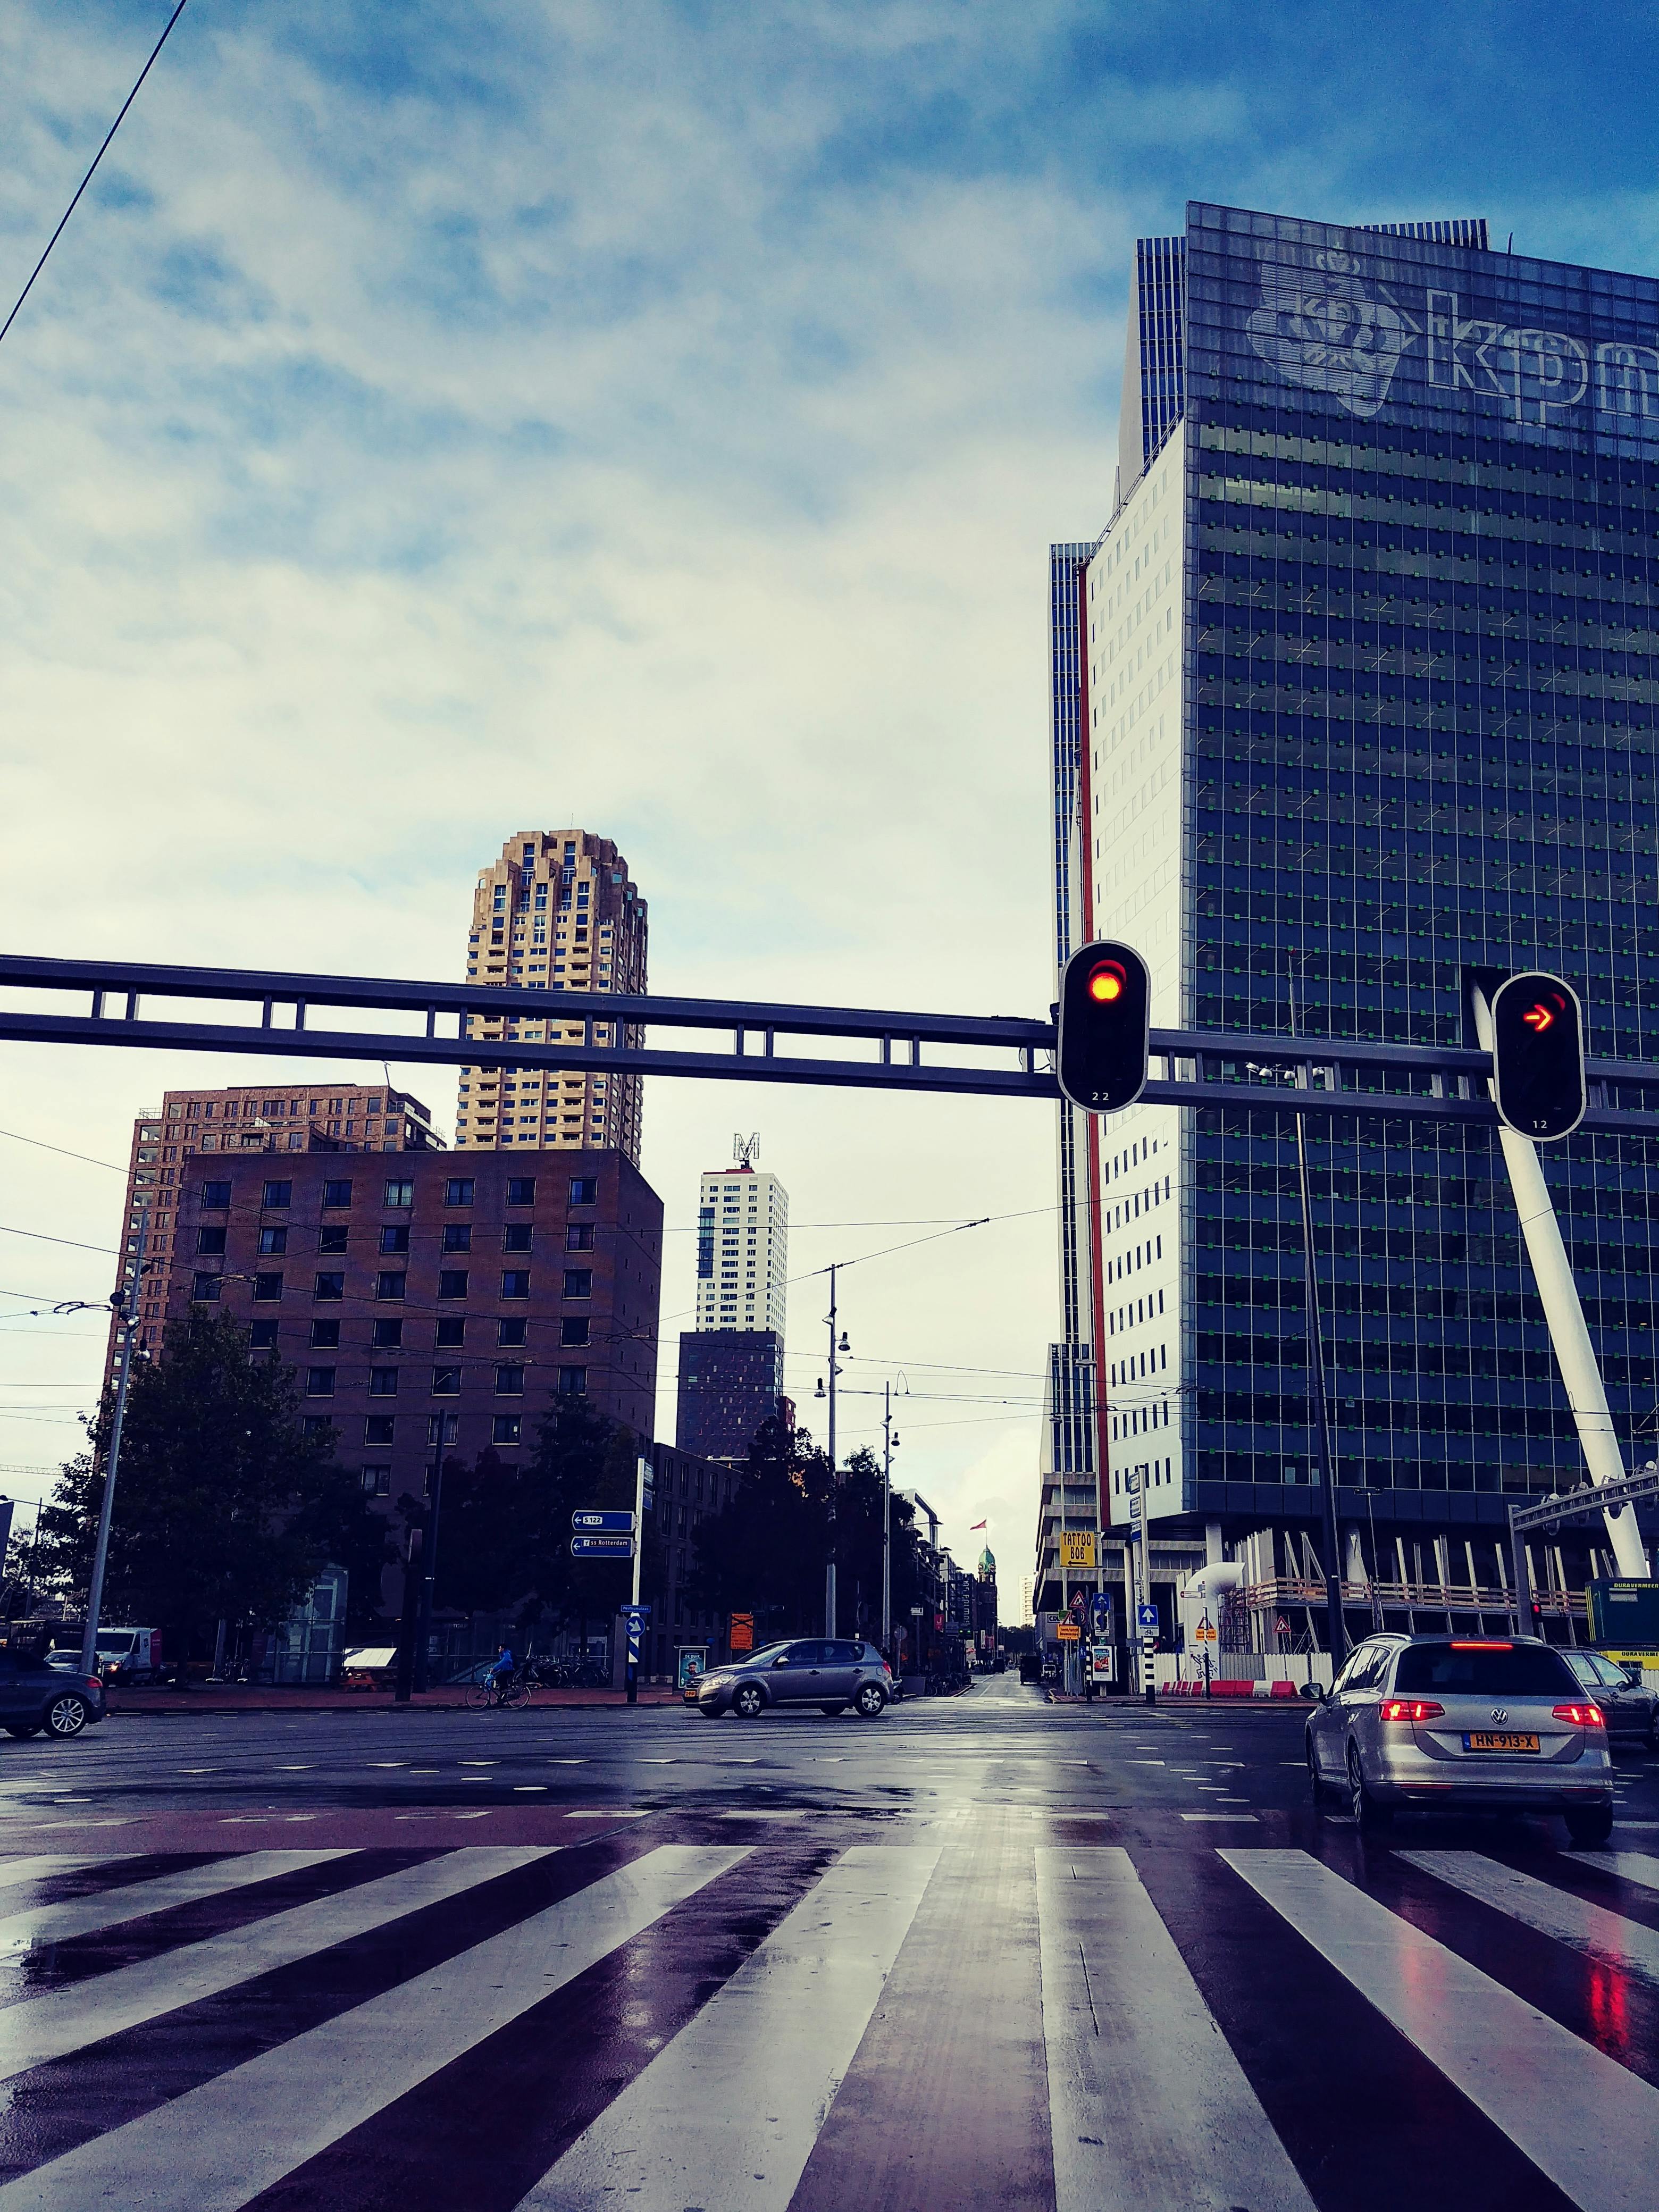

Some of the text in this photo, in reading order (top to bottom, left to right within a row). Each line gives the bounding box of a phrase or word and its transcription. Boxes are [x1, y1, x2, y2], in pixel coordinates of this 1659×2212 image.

[734, 1132, 760, 1159] M
[1063, 1532, 1092, 1546] TATTOO
[1070, 1546, 1085, 1560] BOB
[1476, 1734, 1534, 1748] HN-913-X
